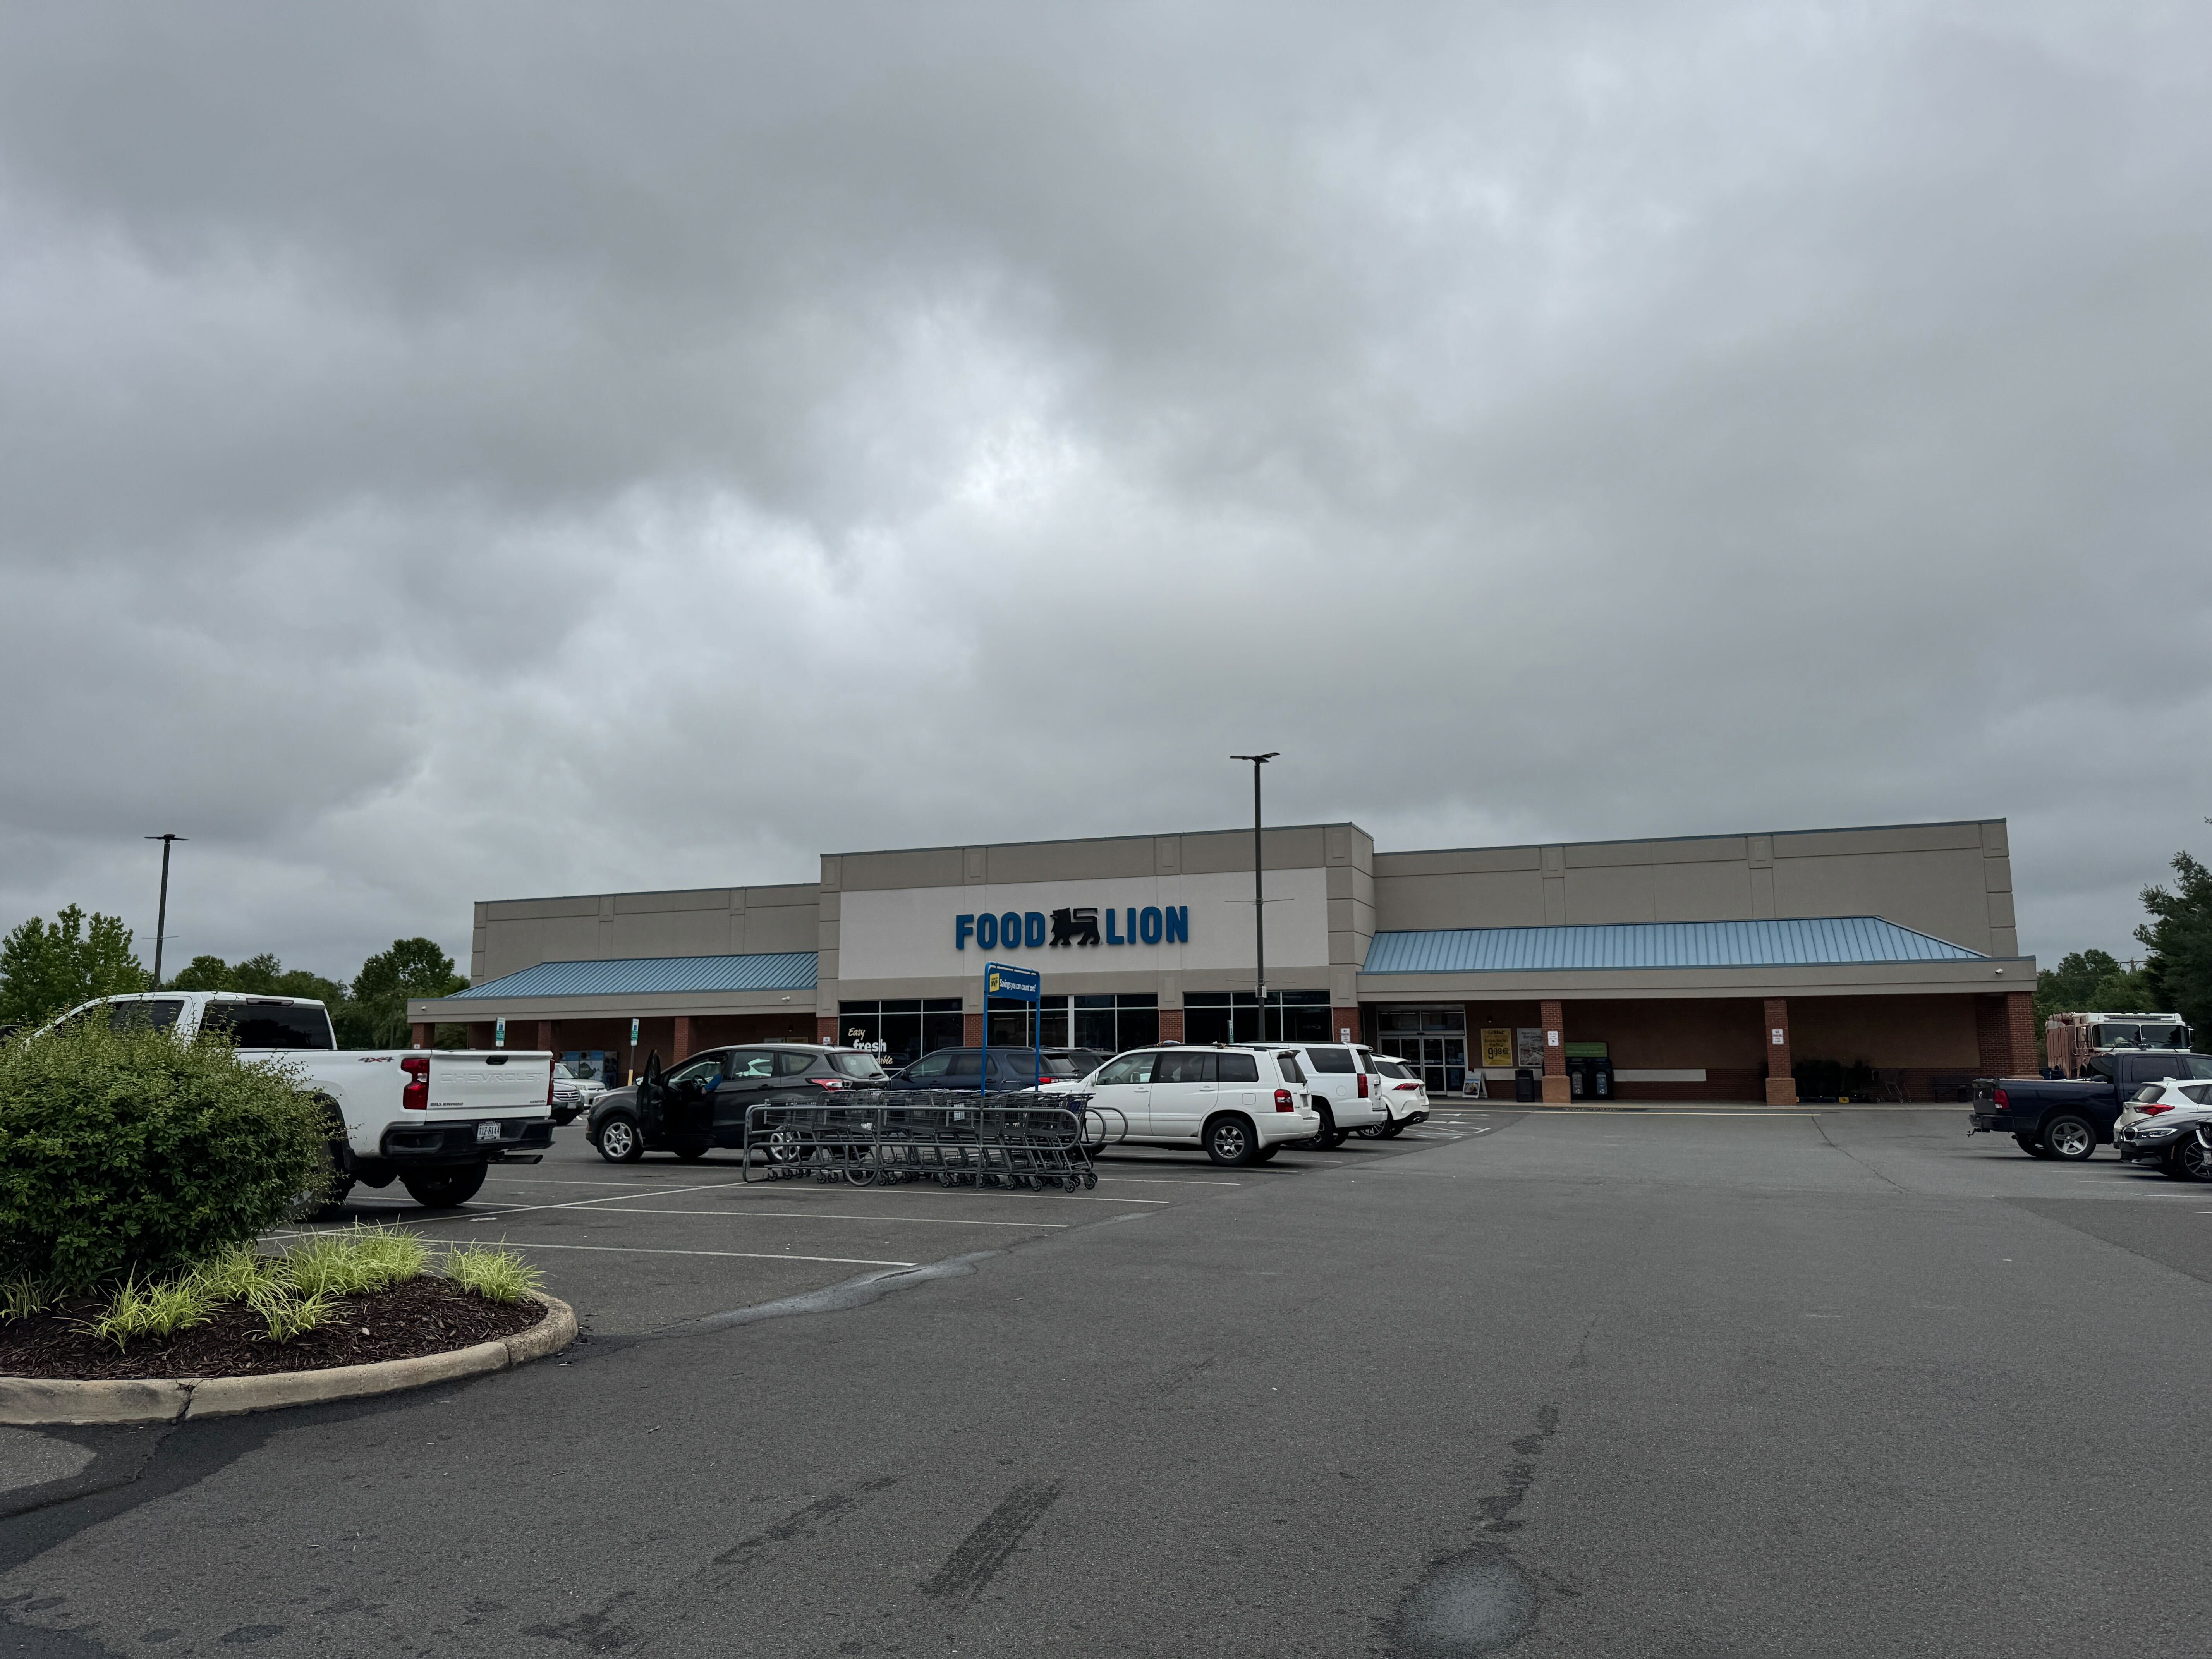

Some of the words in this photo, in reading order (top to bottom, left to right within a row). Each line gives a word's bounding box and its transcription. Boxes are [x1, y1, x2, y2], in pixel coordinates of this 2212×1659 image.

[956, 912, 1046, 949] FOOD
[1106, 905, 1188, 945] LION
[1000, 979, 1011, 990] Savings
[848, 1027, 866, 1040] Easy
[853, 1039, 887, 1052] fresh
[440, 1073, 544, 1083] CHEVROLET
